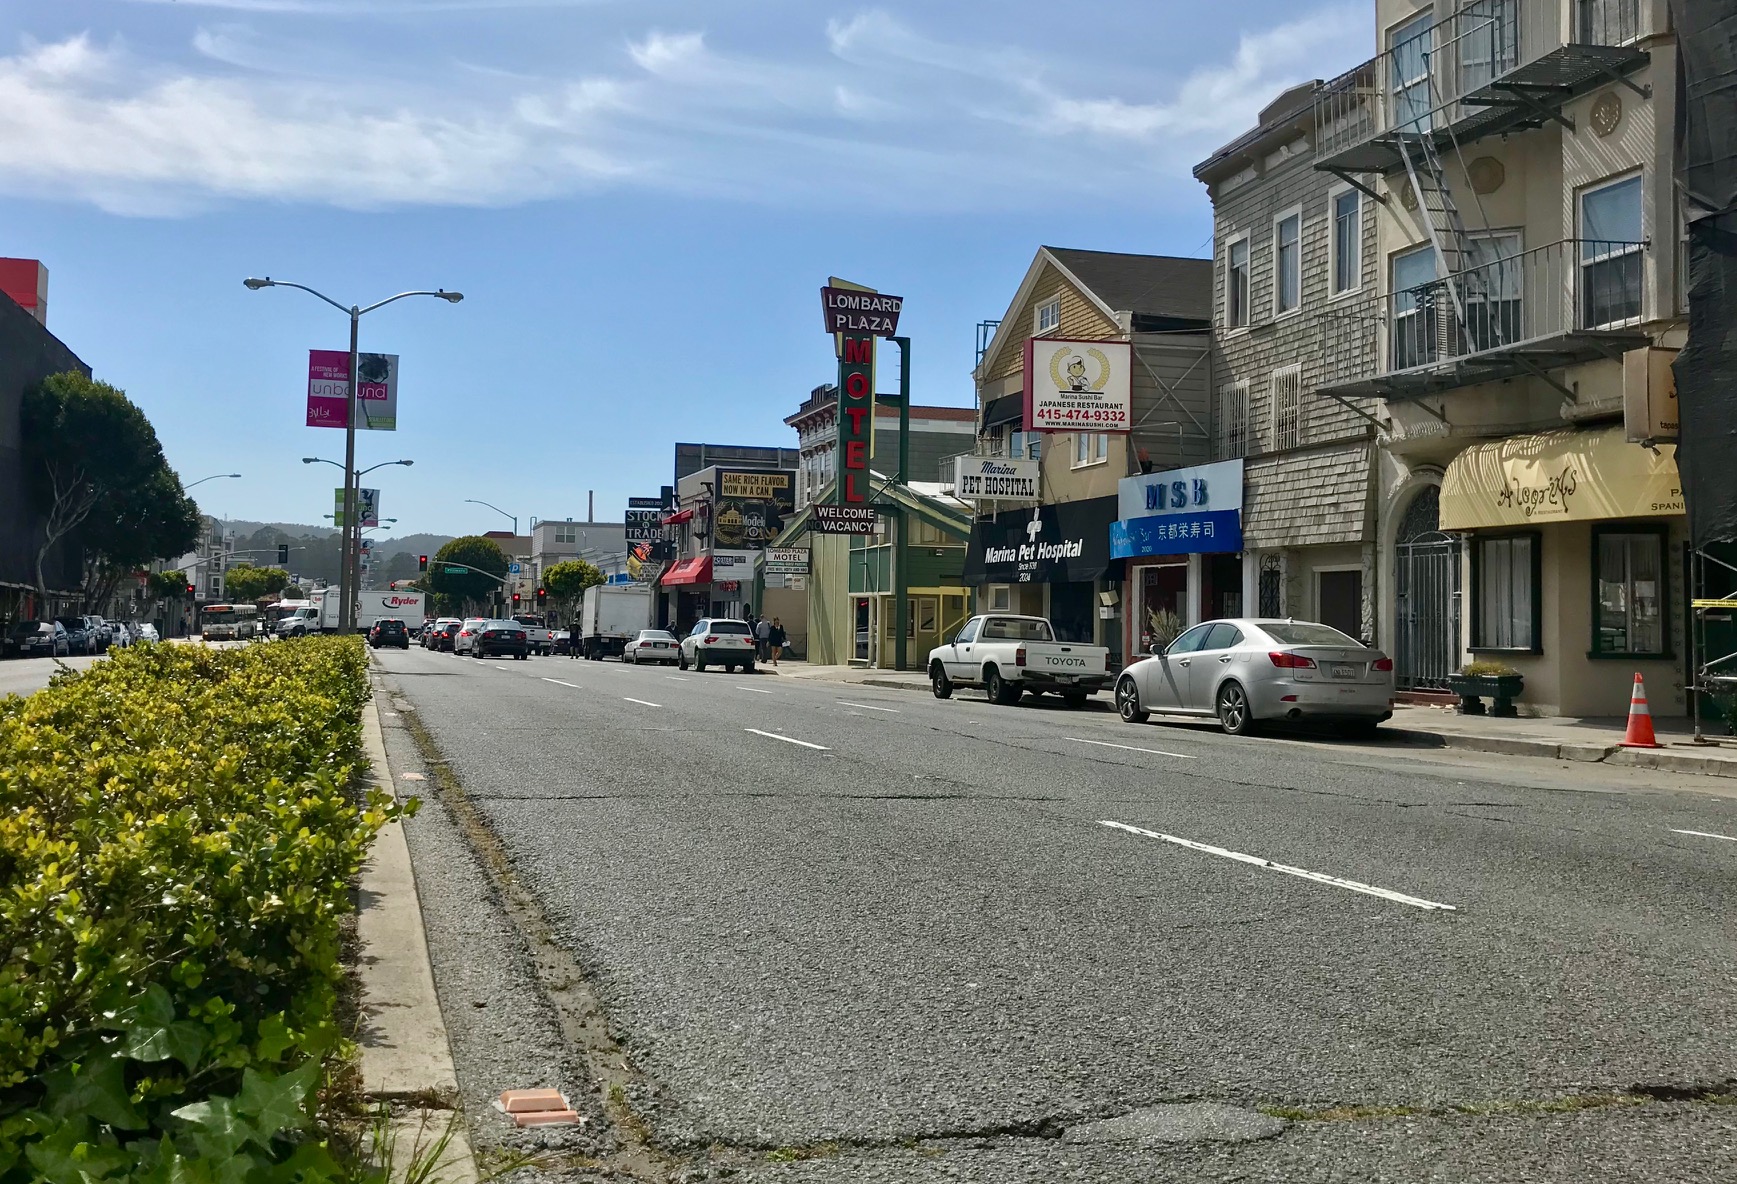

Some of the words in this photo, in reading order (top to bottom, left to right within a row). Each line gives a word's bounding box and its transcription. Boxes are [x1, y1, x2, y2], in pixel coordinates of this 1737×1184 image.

[828, 294, 902, 313] LOMBARD
[836, 314, 894, 331] PLAZA
[845, 337, 870, 503] MOTEL
[1037, 409, 1126, 422] 415-474-9332
[980, 460, 1018, 475] Marina
[723, 474, 742, 484] SAME
[743, 475, 760, 485] RICH
[760, 476, 787, 486] FLAVOR.
[962, 475, 981, 494] PET
[985, 476, 1034, 497] HOSPITAL
[723, 485, 739, 494] NOW
[740, 485, 747, 495] IN
[749, 486, 754, 495] A
[756, 487, 771, 496] CAN.
[627, 511, 663, 521] STOCK
[818, 507, 874, 519] WELCOME
[822, 520, 873, 532] VACANCY
[1158, 521, 1215, 540] 京都栄寿司
[626, 528, 663, 539] TRADE
[984, 546, 1016, 563] Marina
[1018, 543, 1035, 561] Pet
[1037, 538, 1083, 563] Hospital
[390, 596, 419, 606] Ryder
[1045, 656, 1086, 667] TOYOTA
